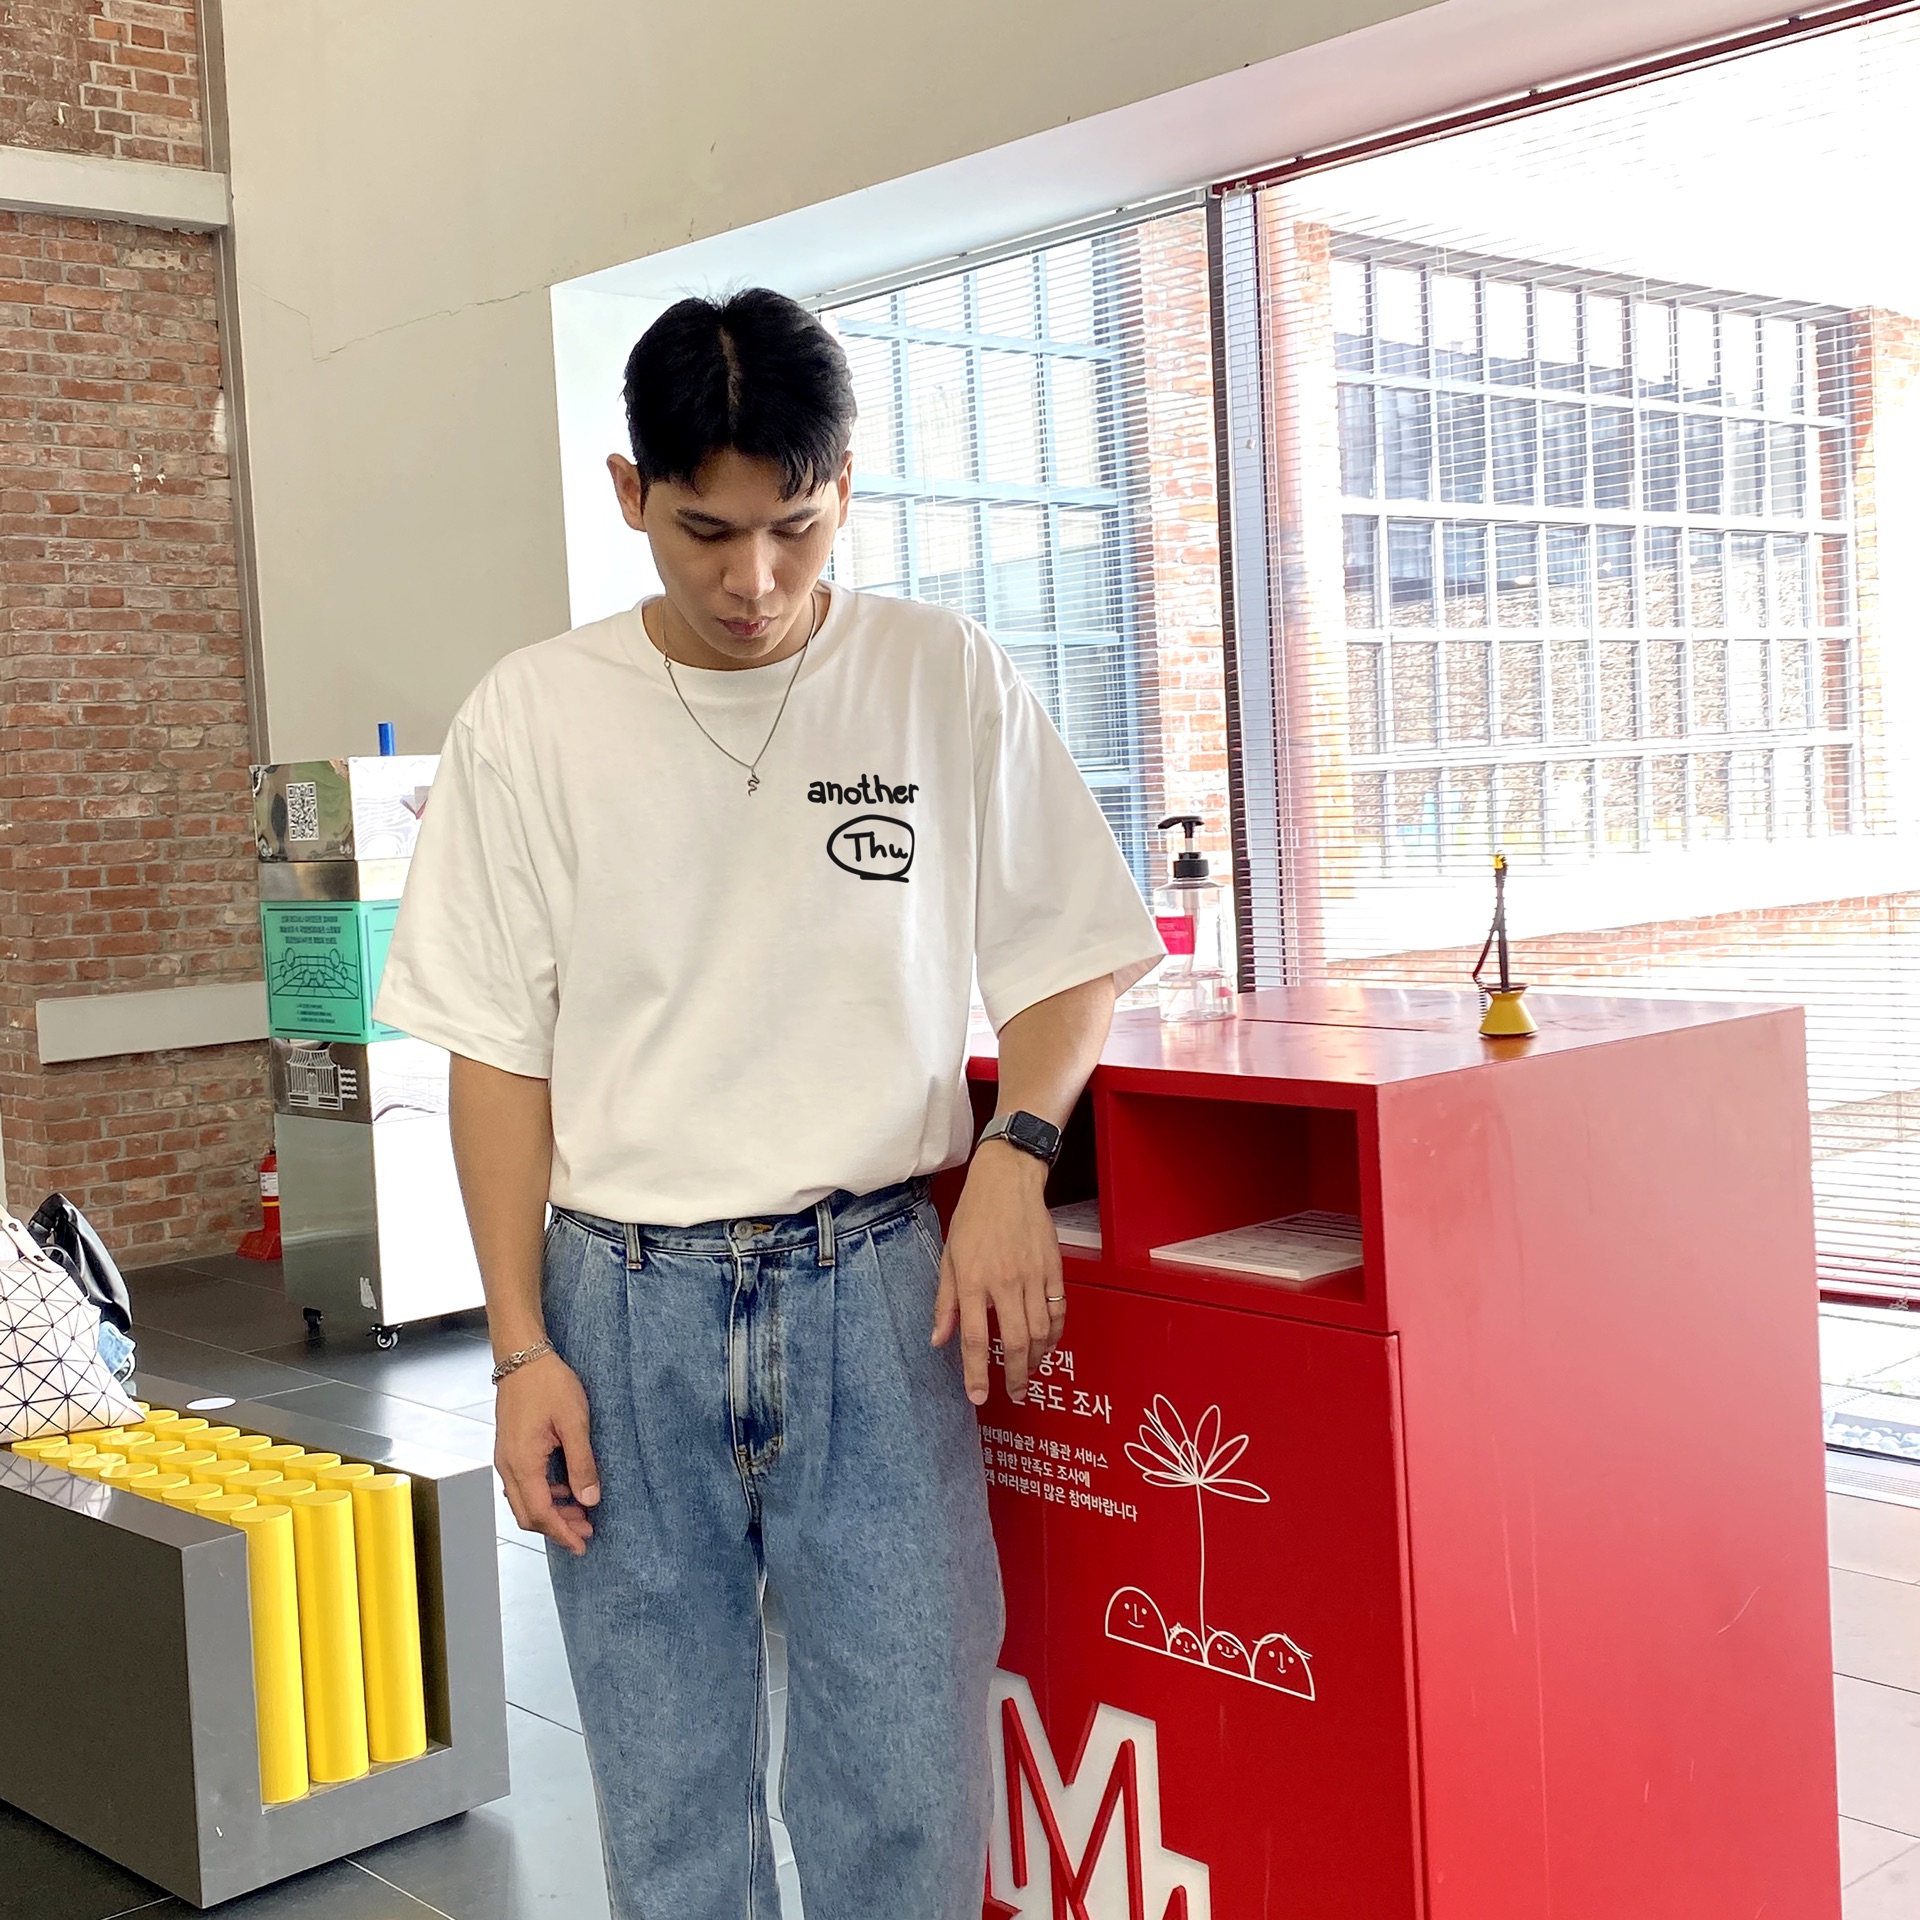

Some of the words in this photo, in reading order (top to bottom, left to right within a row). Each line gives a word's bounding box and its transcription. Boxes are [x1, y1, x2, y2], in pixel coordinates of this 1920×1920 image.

[807, 773, 920, 805] another
[843, 830, 909, 862] Thu
[1039, 1350, 1075, 1381] 용객
[1012, 1379, 1067, 1412] 족도
[1072, 1390, 1113, 1425] 조사
[983, 1447, 994, 1465] 을
[996, 1450, 1018, 1471] 위한
[1020, 1456, 1054, 1478] 만족도
[1056, 1464, 1091, 1488] 조사에
[1038, 1439, 1071, 1462] 서울관
[1074, 1447, 1109, 1469] 서비스
[997, 1472, 1041, 1498] 여러분의
[1043, 1483, 1066, 1505] 많은
[1069, 1489, 1138, 1523] 참여바랍니다
